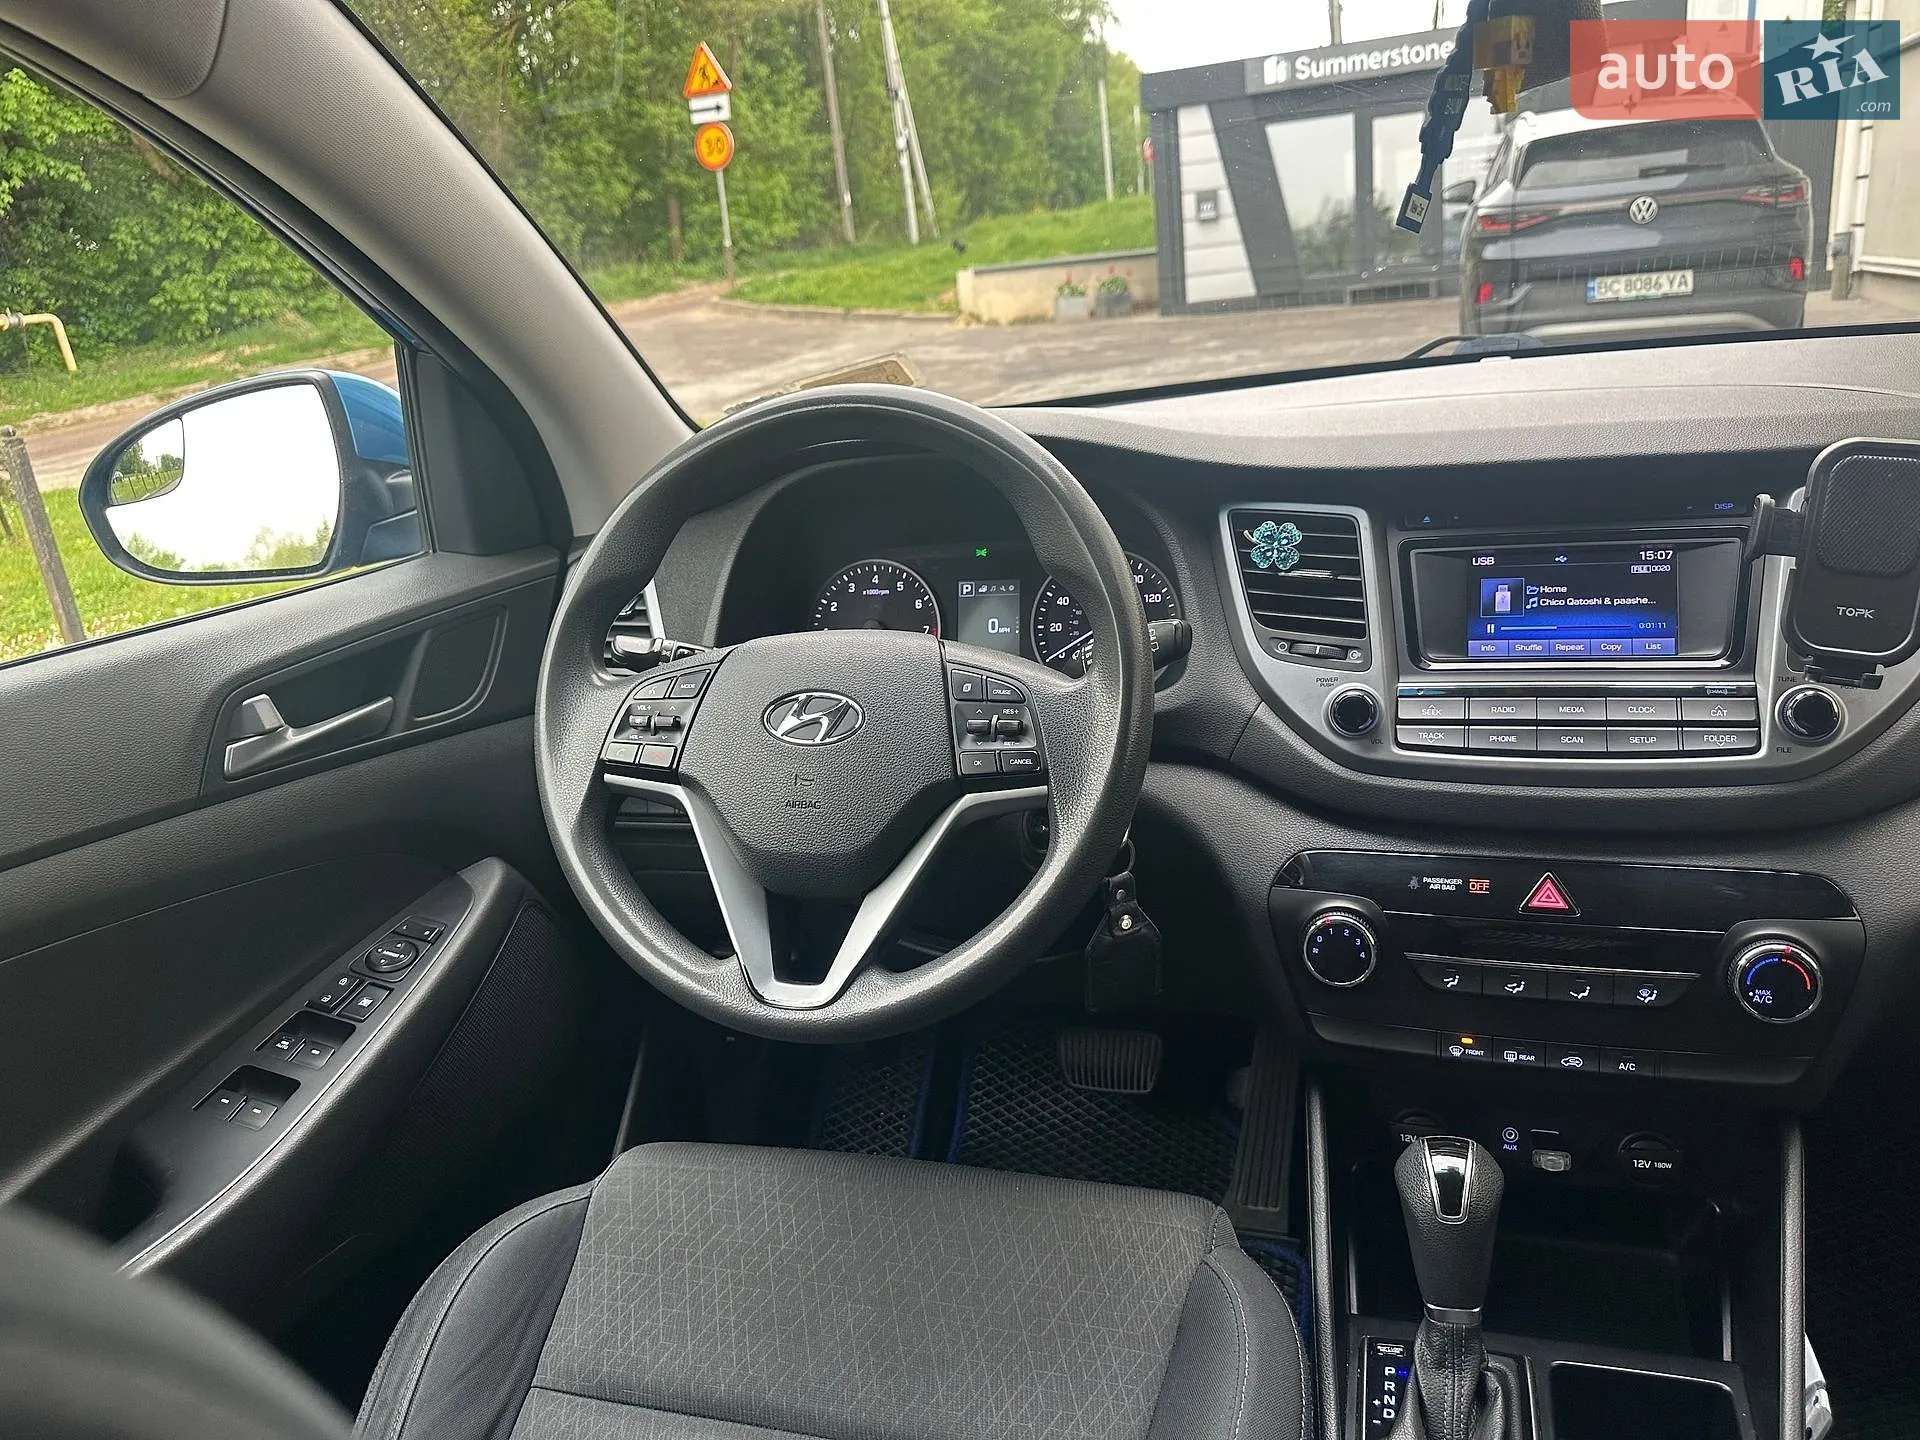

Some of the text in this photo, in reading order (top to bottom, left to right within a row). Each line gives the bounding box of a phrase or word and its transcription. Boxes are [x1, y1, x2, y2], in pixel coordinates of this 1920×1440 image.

[1295, 40, 1456, 81] Summerstone
[1639, 550, 1673, 560] 15:07
[1472, 556, 1495, 566] USB
[872, 575, 880, 584] 4
[848, 583, 856, 592] 3
[896, 581, 904, 591] 5
[962, 584, 972, 595] P
[1540, 585, 1567, 593] Home
[1056, 596, 1070, 606] 40
[1143, 594, 1162, 603] 120
[1540, 598, 1565, 606] Chico
[1566, 597, 1602, 606] Qatoshi
[1603, 597, 1612, 605] &
[830, 602, 838, 612] 2
[914, 599, 923, 609] 6
[1836, 606, 1875, 619] TOPK
[988, 618, 999, 634] 0
[1049, 623, 1063, 632] 20
[1515, 643, 1542, 651] Shuffle
[1555, 643, 1585, 652] Repeat
[1600, 643, 1623, 652] Copy
[1645, 642, 1662, 650] List
[1710, 709, 1728, 717] CAT
[1418, 732, 1445, 740] TRACK
[1489, 735, 1517, 743] PHONE
[1629, 736, 1657, 744] SETUP
[1703, 734, 1737, 743] FOLDER
[785, 800, 821, 809] AIRBAG
[1423, 876, 1463, 885] PASSENGER
[1469, 882, 1490, 890] OFF
[1316, 935, 1323, 943] 0
[1360, 951, 1366, 959] 4
[1752, 994, 1773, 1004] A/C
[1465, 1049, 1485, 1057] FRONT
[1618, 1062, 1636, 1071] A/C
[1400, 1133, 1417, 1143] 12V
[1632, 1159, 1652, 1169] 12V
[1384, 1366, 1396, 1376] P
[1384, 1381, 1396, 1392] R
[1383, 1394, 1396, 1405] N
[1382, 1408, 1396, 1419] D
